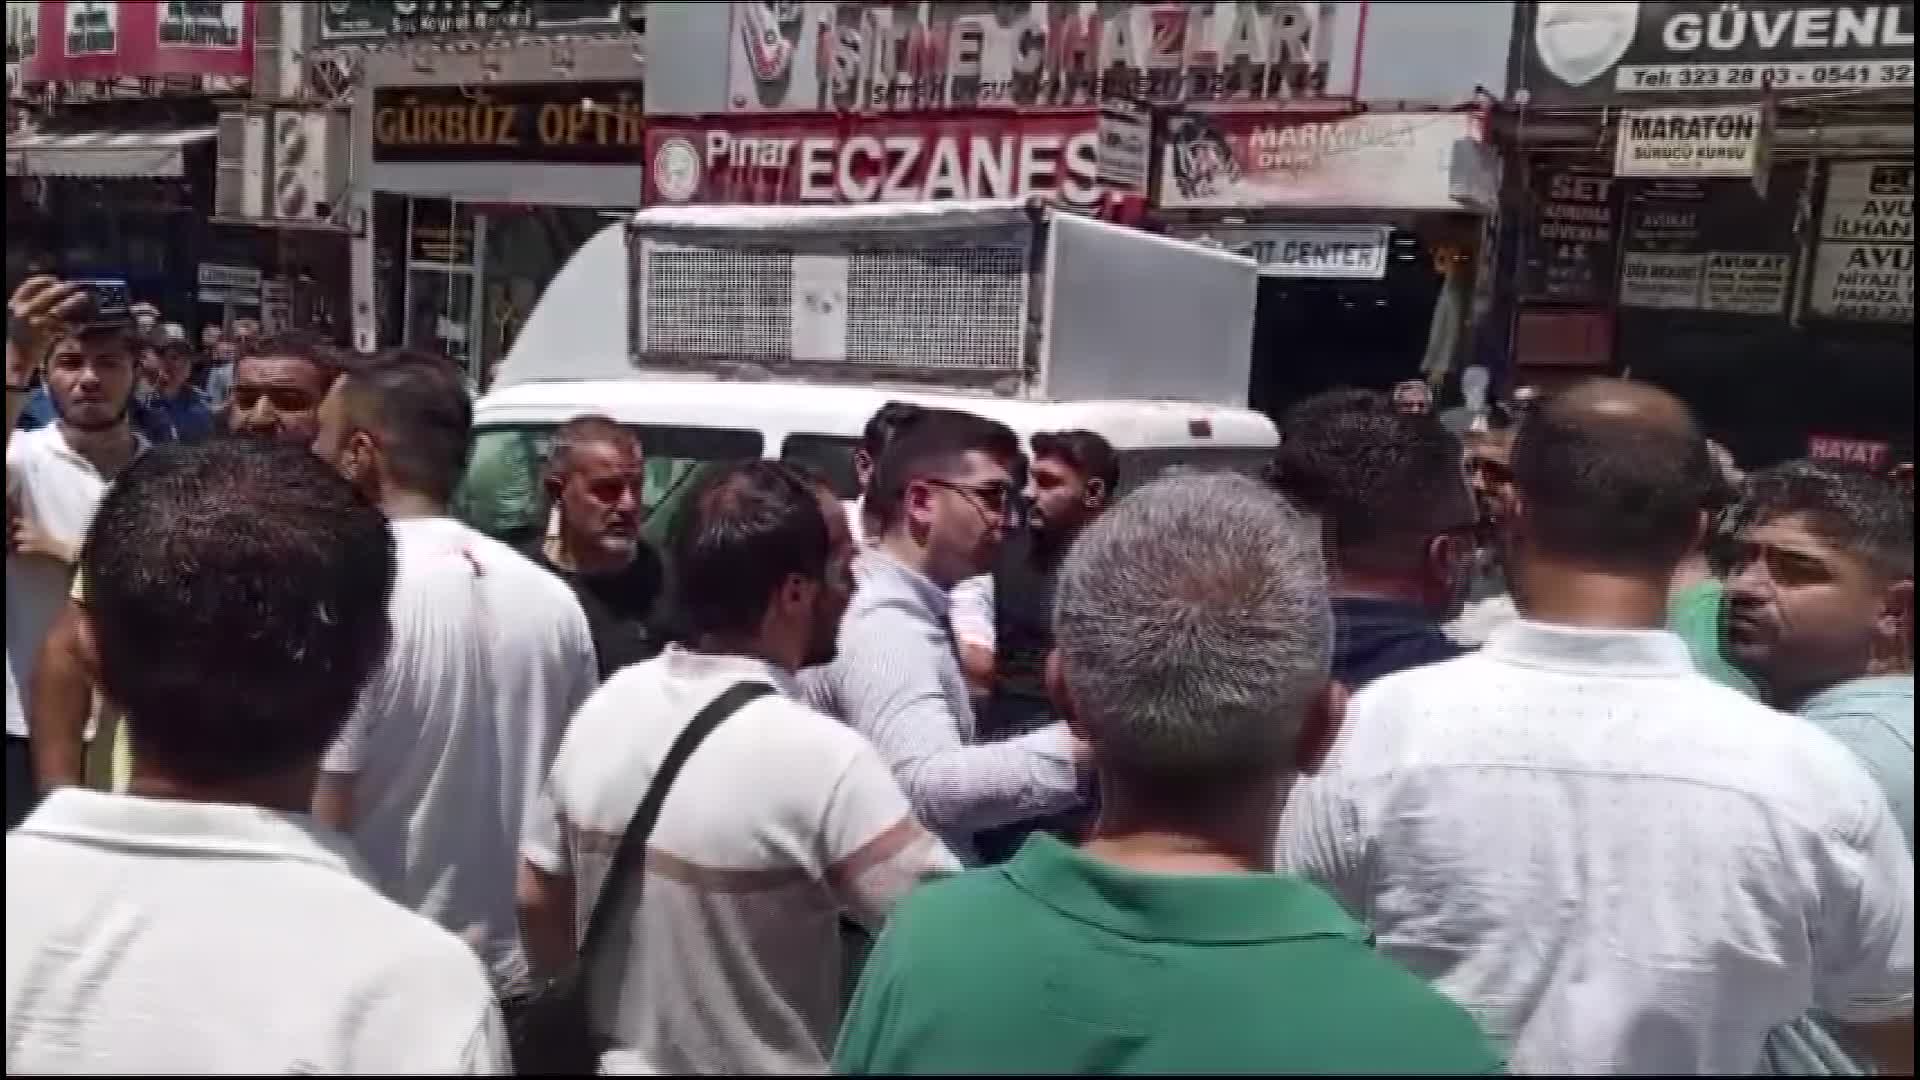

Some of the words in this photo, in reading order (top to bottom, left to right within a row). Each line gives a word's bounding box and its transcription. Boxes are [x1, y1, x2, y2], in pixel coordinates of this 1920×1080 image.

[1662, 3, 1914, 51] GÜVENL
[1633, 69, 1672, 87] Tel:
[1679, 67, 1719, 85] 323
[1812, 64, 1870, 83] 0541
[1880, 63, 1914, 82] 32
[373, 96, 521, 146] GÜRBÜZ
[1630, 114, 1753, 140] MARATON
[799, 133, 1103, 202] ECZANES
[1551, 175, 1613, 201] SET
[1833, 213, 1911, 236] İLHAN
[1282, 239, 1374, 268] CENTER
[1811, 437, 1886, 464] HAYAT
